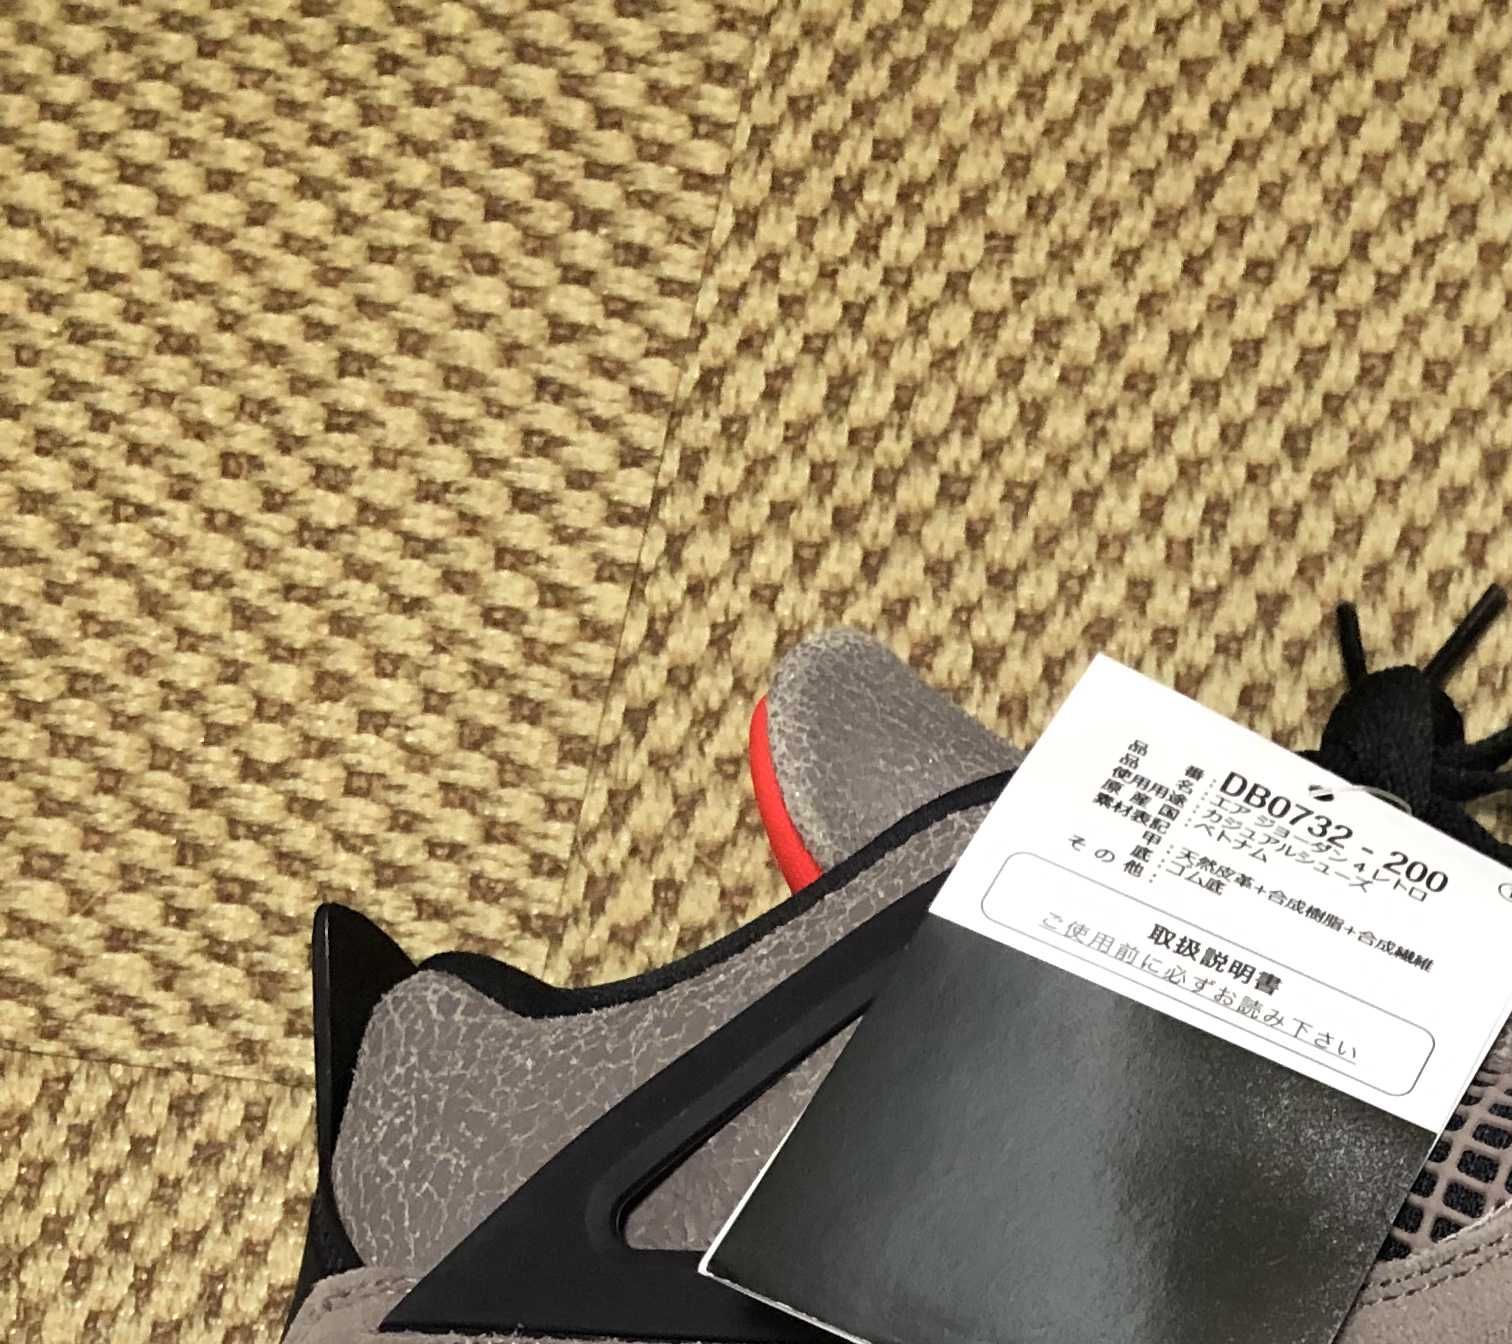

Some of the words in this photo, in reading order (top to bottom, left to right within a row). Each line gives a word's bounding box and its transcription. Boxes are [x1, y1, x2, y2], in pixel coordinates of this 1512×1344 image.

[1092, 792, 1171, 835] 素材表記
[1194, 823, 1268, 864] ベトナム
[1220, 771, 1353, 848] DB0732
[1382, 850, 1449, 893] 200
[1041, 912, 1358, 1060] ご使用前に必ずお読み下さい
[1147, 923, 1283, 997] 取扱説明書
